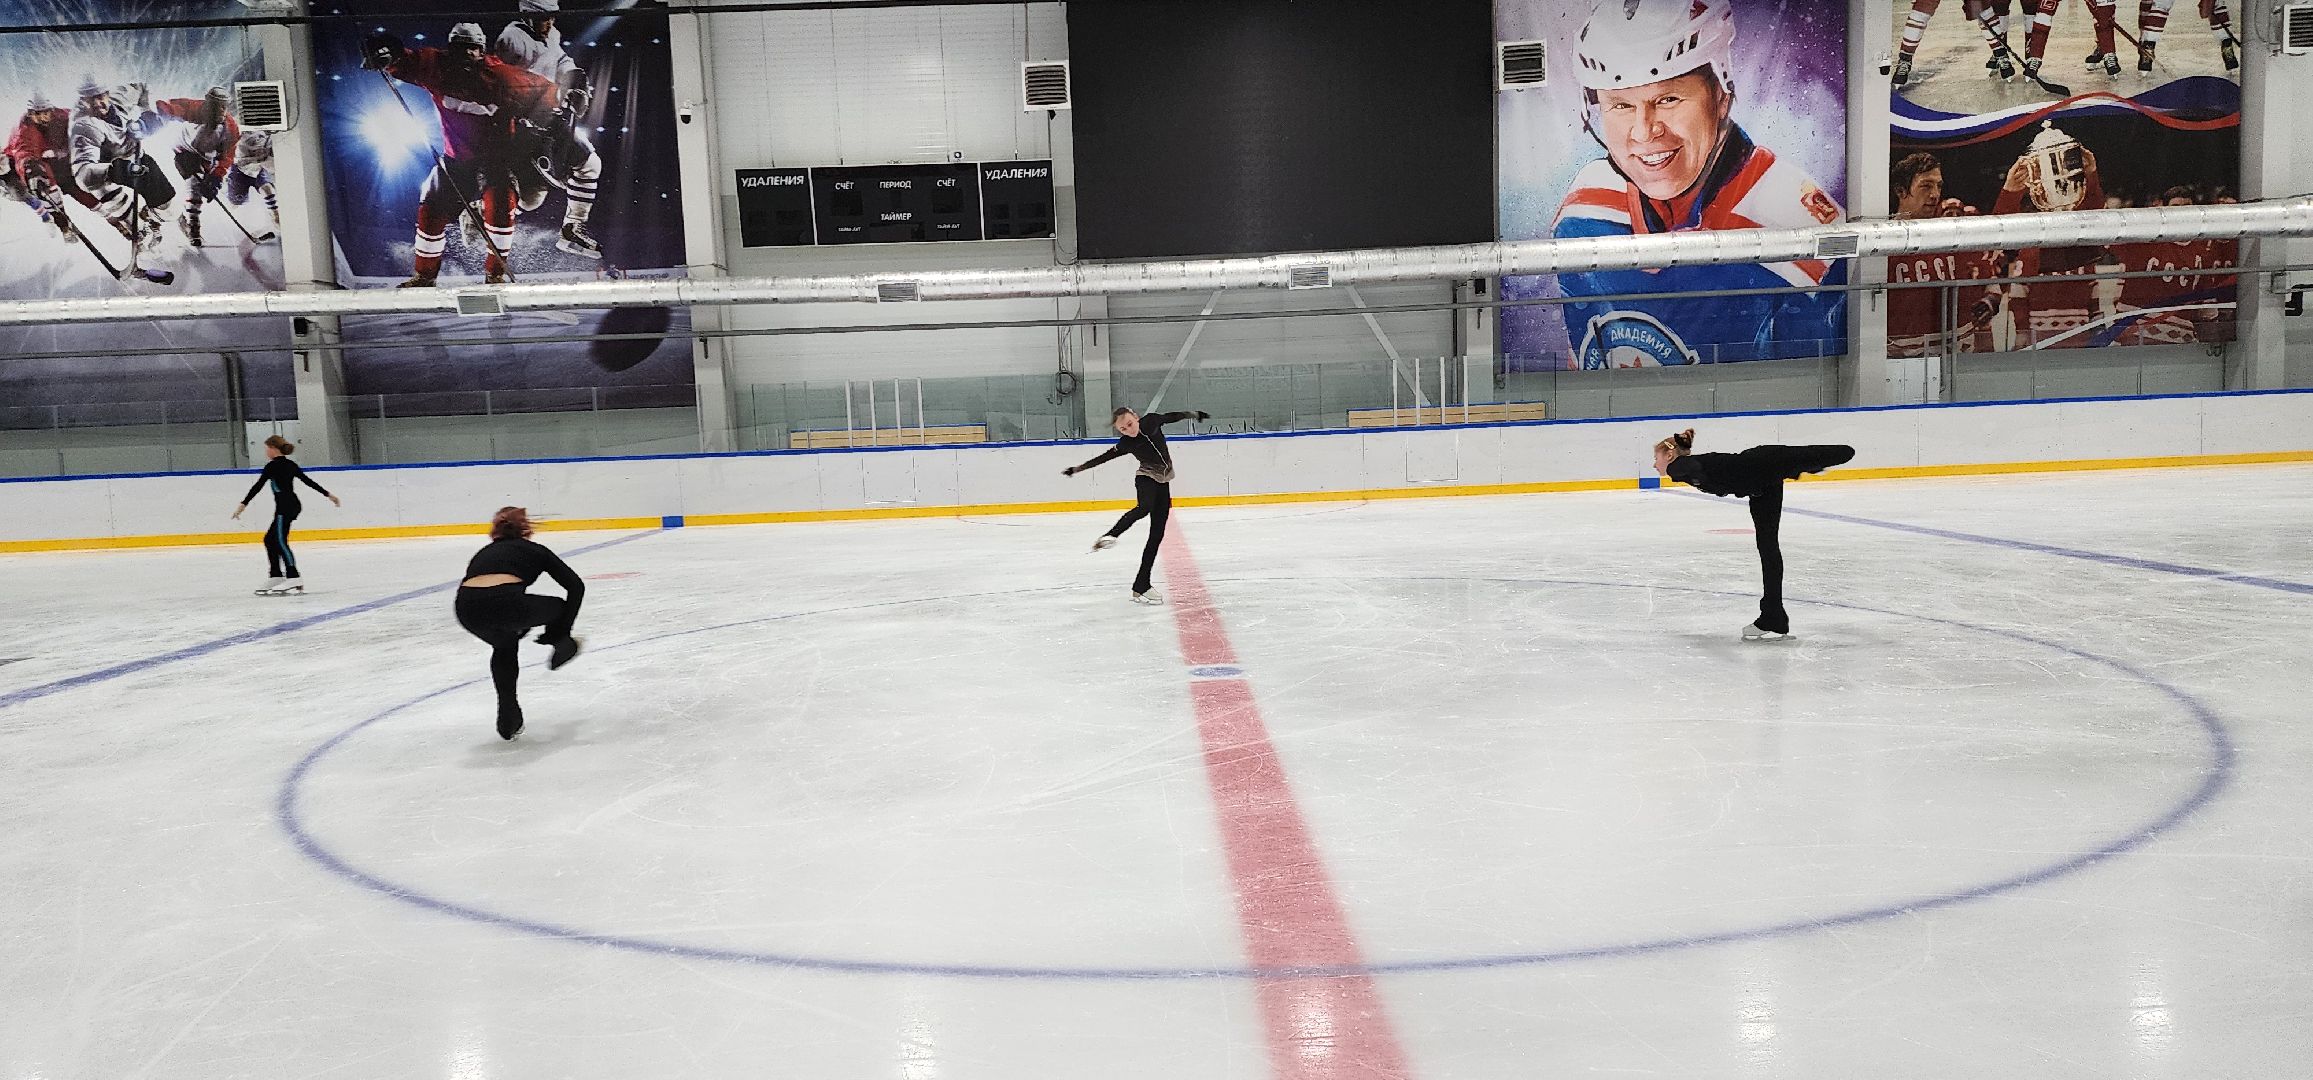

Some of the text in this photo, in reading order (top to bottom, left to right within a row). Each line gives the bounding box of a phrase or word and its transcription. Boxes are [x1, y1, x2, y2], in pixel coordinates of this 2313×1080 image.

[984, 167, 1048, 181] УДАЛЕНИЯ
[739, 174, 805, 188] УДАЛЕНИЯ
[834, 180, 855, 191] СЧЁТ
[879, 179, 912, 190] ПЕРИОД
[936, 177, 956, 188] СЧЁТ
[880, 211, 913, 222] ТАЙМЕР
[1895, 255, 1956, 283] СССР
[1611, 327, 1672, 358] АКАДЕМИЯ
